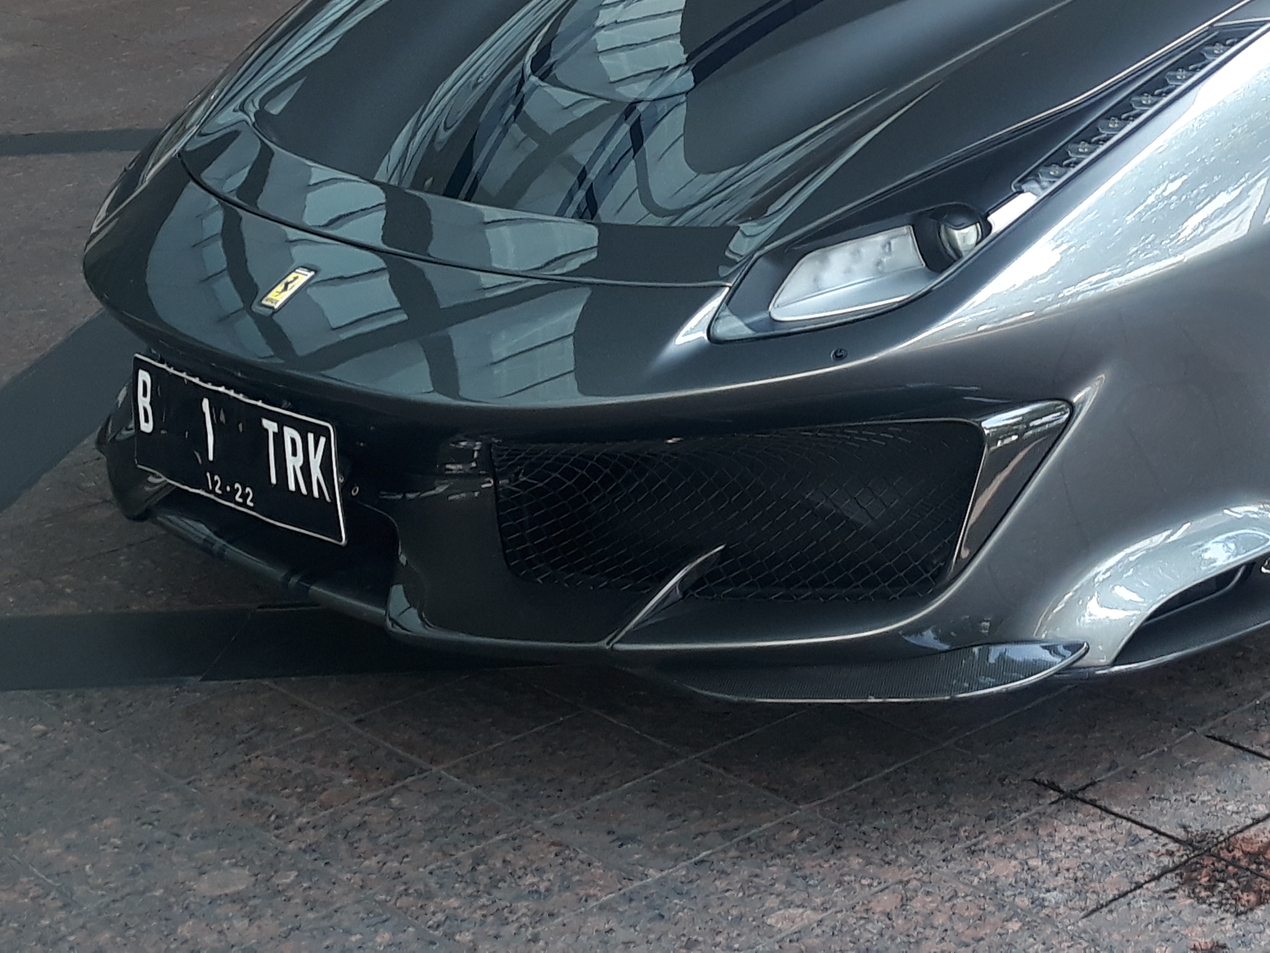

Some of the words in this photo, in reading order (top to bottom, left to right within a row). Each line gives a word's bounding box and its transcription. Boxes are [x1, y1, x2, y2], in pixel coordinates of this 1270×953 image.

[137, 368, 154, 434] B
[202, 397, 214, 462] 1
[261, 417, 332, 503] TRK
